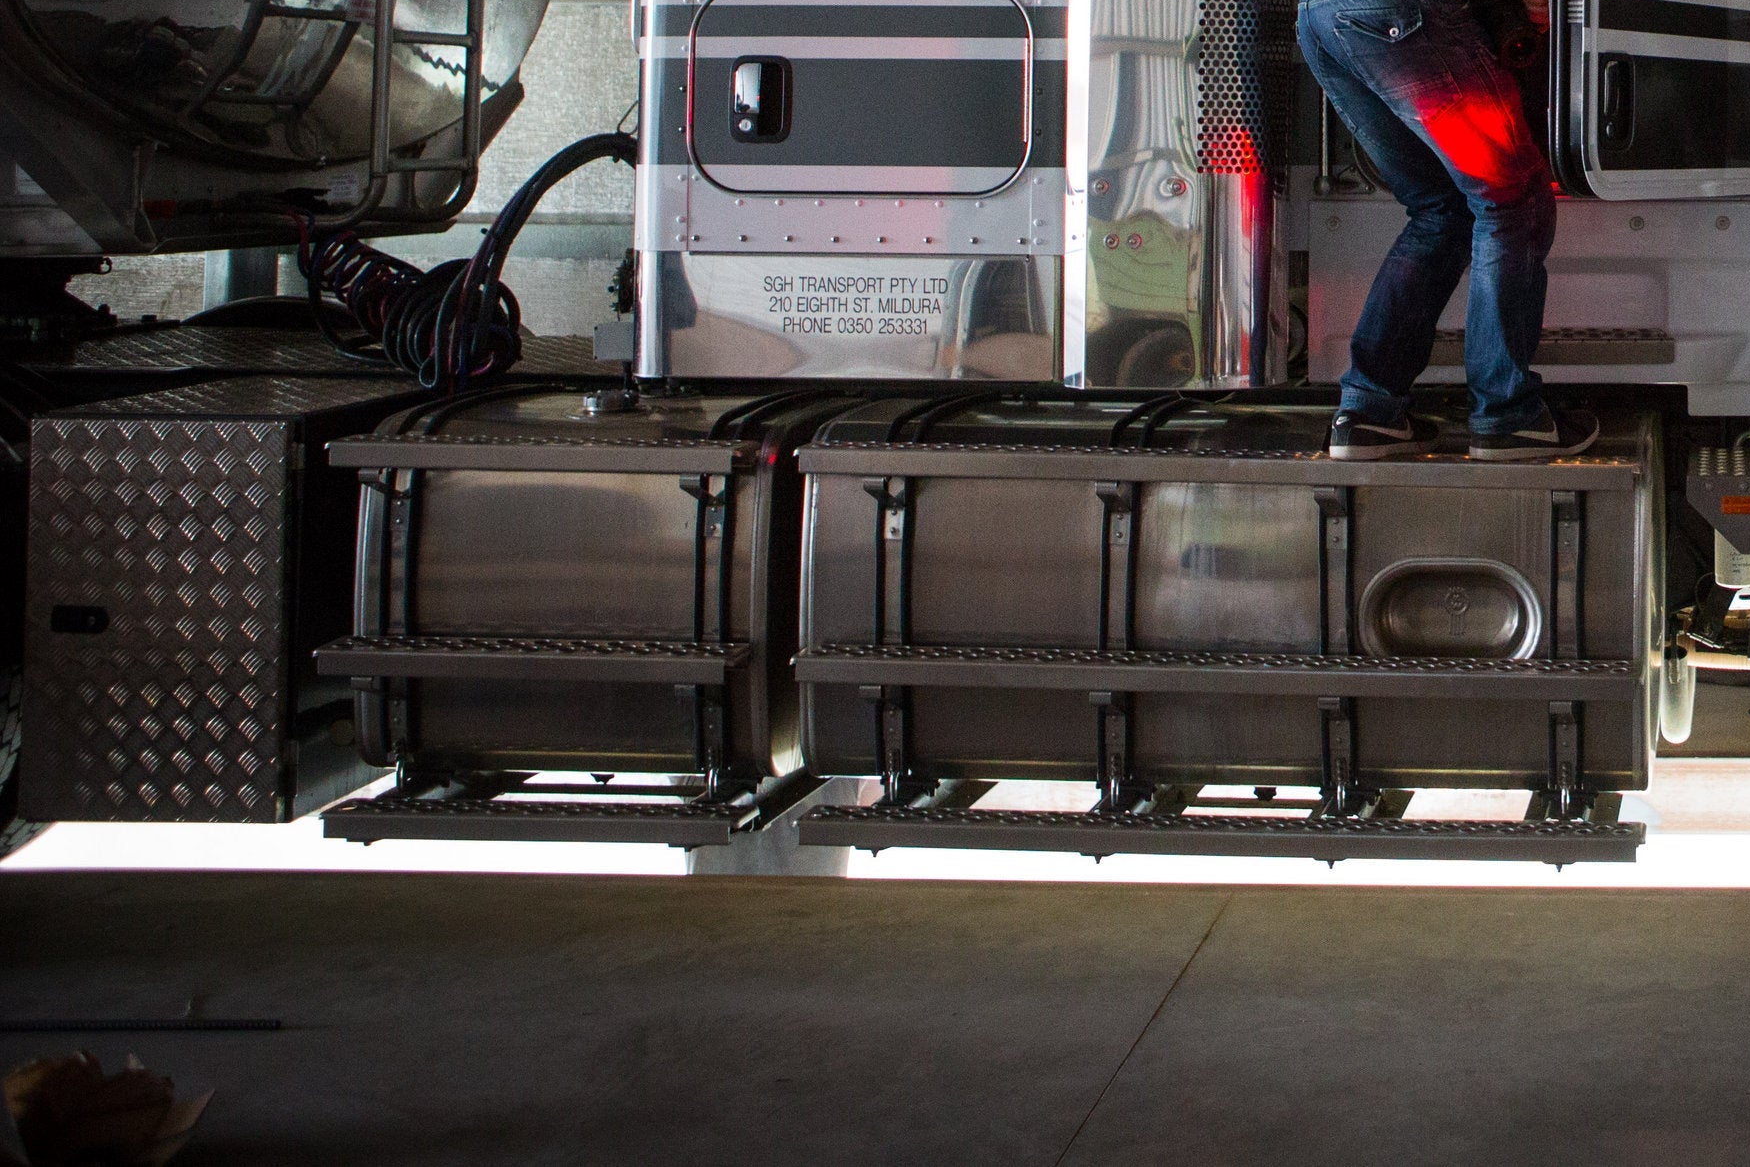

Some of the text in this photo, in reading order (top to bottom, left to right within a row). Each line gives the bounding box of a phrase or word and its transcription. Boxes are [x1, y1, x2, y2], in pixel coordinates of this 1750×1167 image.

[763, 276, 948, 294] SGH TRANSPORT PTY LTD
[769, 296, 942, 314] 210 EIGHTH ST. MILDURA
[783, 317, 928, 335] PHONE 0350 253331
